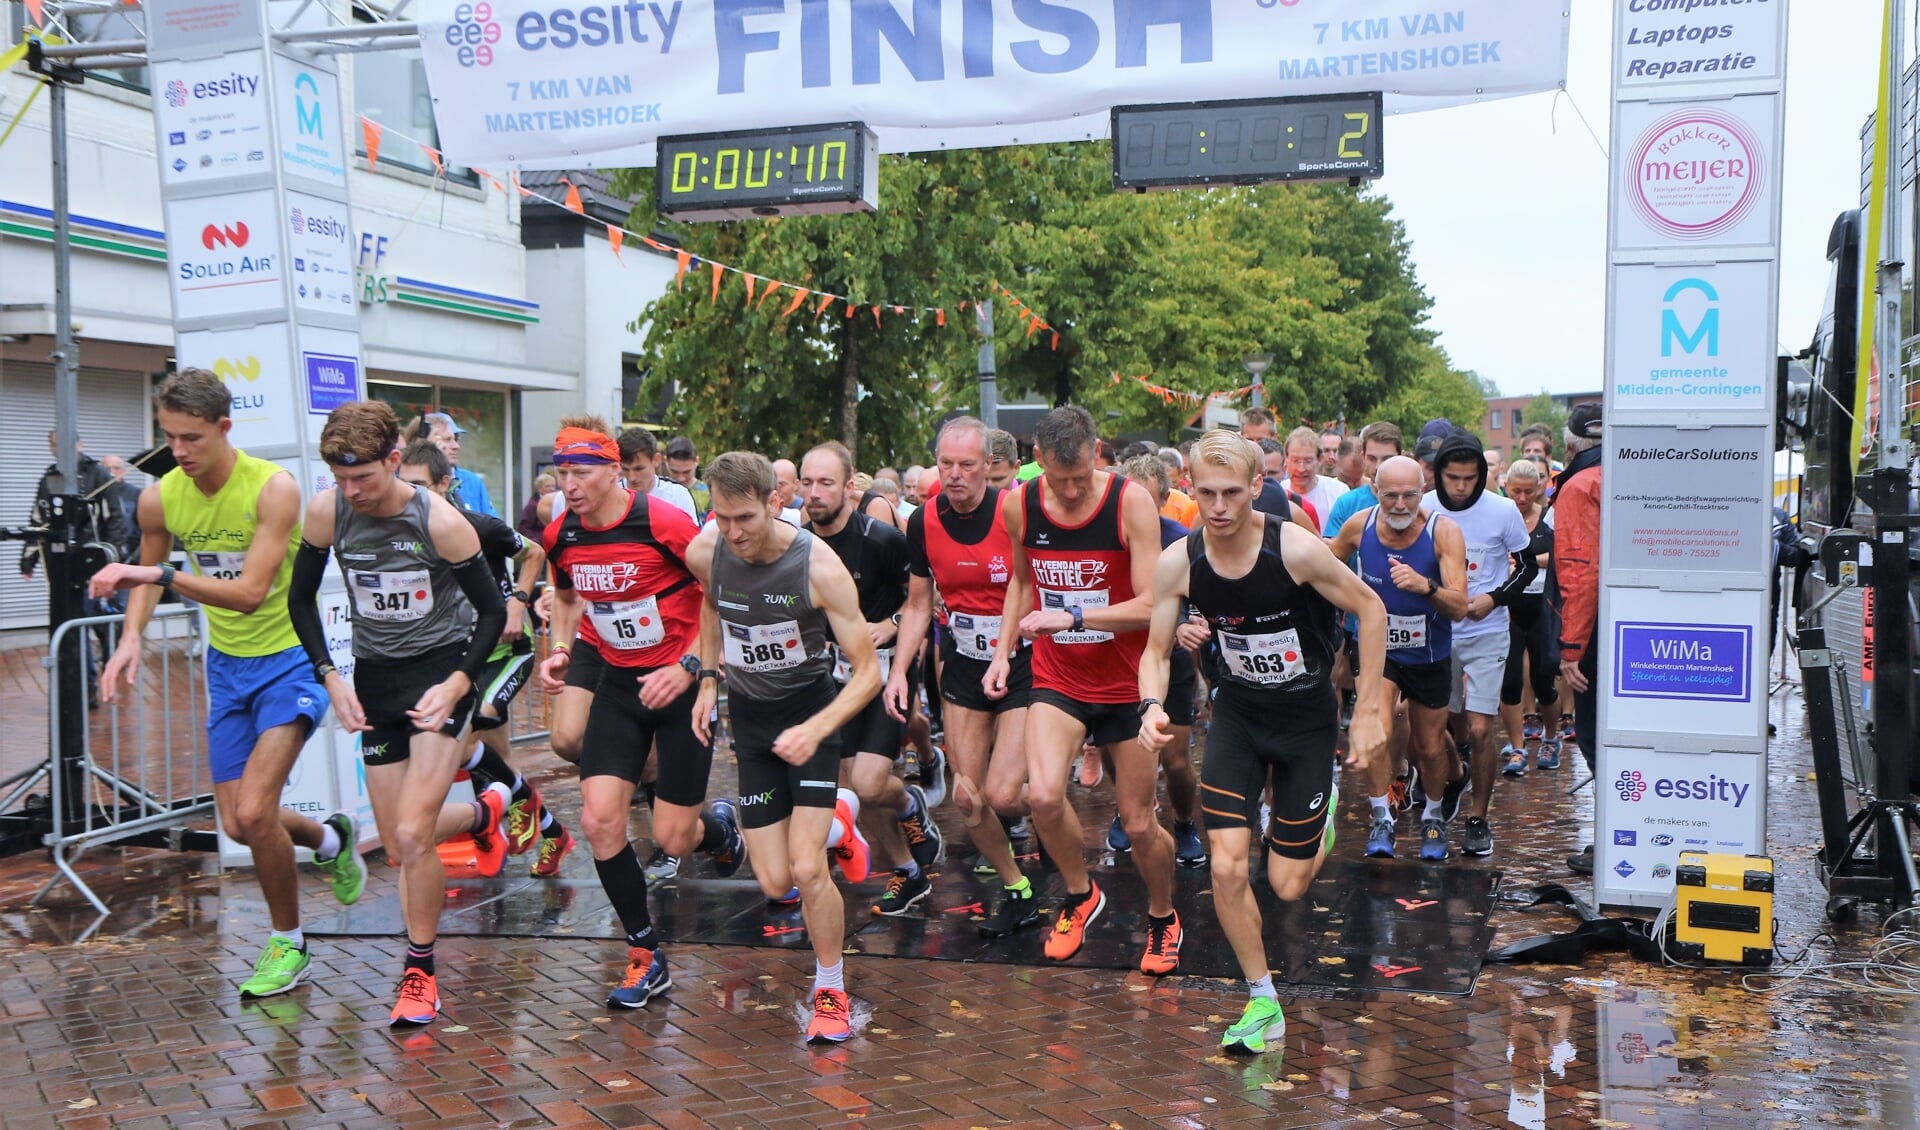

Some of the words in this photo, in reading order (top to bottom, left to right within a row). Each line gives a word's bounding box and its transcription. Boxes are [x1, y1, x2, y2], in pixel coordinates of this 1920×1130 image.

[516, 0, 682, 54] essity
[1313, 22, 1330, 45] 7
[1341, 17, 1389, 42] KM
[1400, 10, 1465, 37] VAN
[1627, 24, 1734, 47] Laptops
[714, 0, 1213, 95] FINISH
[1278, 41, 1501, 80] MARTENSHOEK
[1626, 52, 1757, 79] Reparatie
[193, 73, 260, 99] essity
[506, 81, 521, 101] 7
[529, 79, 569, 100] KM
[576, 74, 632, 97] VAN
[484, 103, 662, 134] MARTENSHOEK
[1298, 160, 1369, 172] SportsCom.nl
[793, 185, 844, 195] SportsCom.nl
[307, 216, 346, 244] essity
[180, 262, 234, 280] SOLID
[1650, 366, 1728, 381] gemeente
[1617, 383, 1762, 397] Midden-Groningen
[1618, 448, 1759, 461] MobileCarSolutions
[372, 592, 409, 611] 347
[763, 593, 800, 607] RUNX
[612, 619, 637, 639] 15
[975, 634, 987, 651] 6
[1650, 639, 1713, 661] WiMa
[741, 643, 785, 665] 586
[1239, 653, 1285, 674] 363
[1863, 636, 1873, 671] AMF
[1630, 661, 1685, 671] Winkelcentrum
[1685, 664, 1734, 673] Martenshoek
[1630, 671, 1667, 683] Sfeervol
[1654, 774, 1750, 808] essity
[1644, 816, 1656, 825] de
[1657, 818, 1690, 827] makers
[1691, 820, 1710, 828] van:
